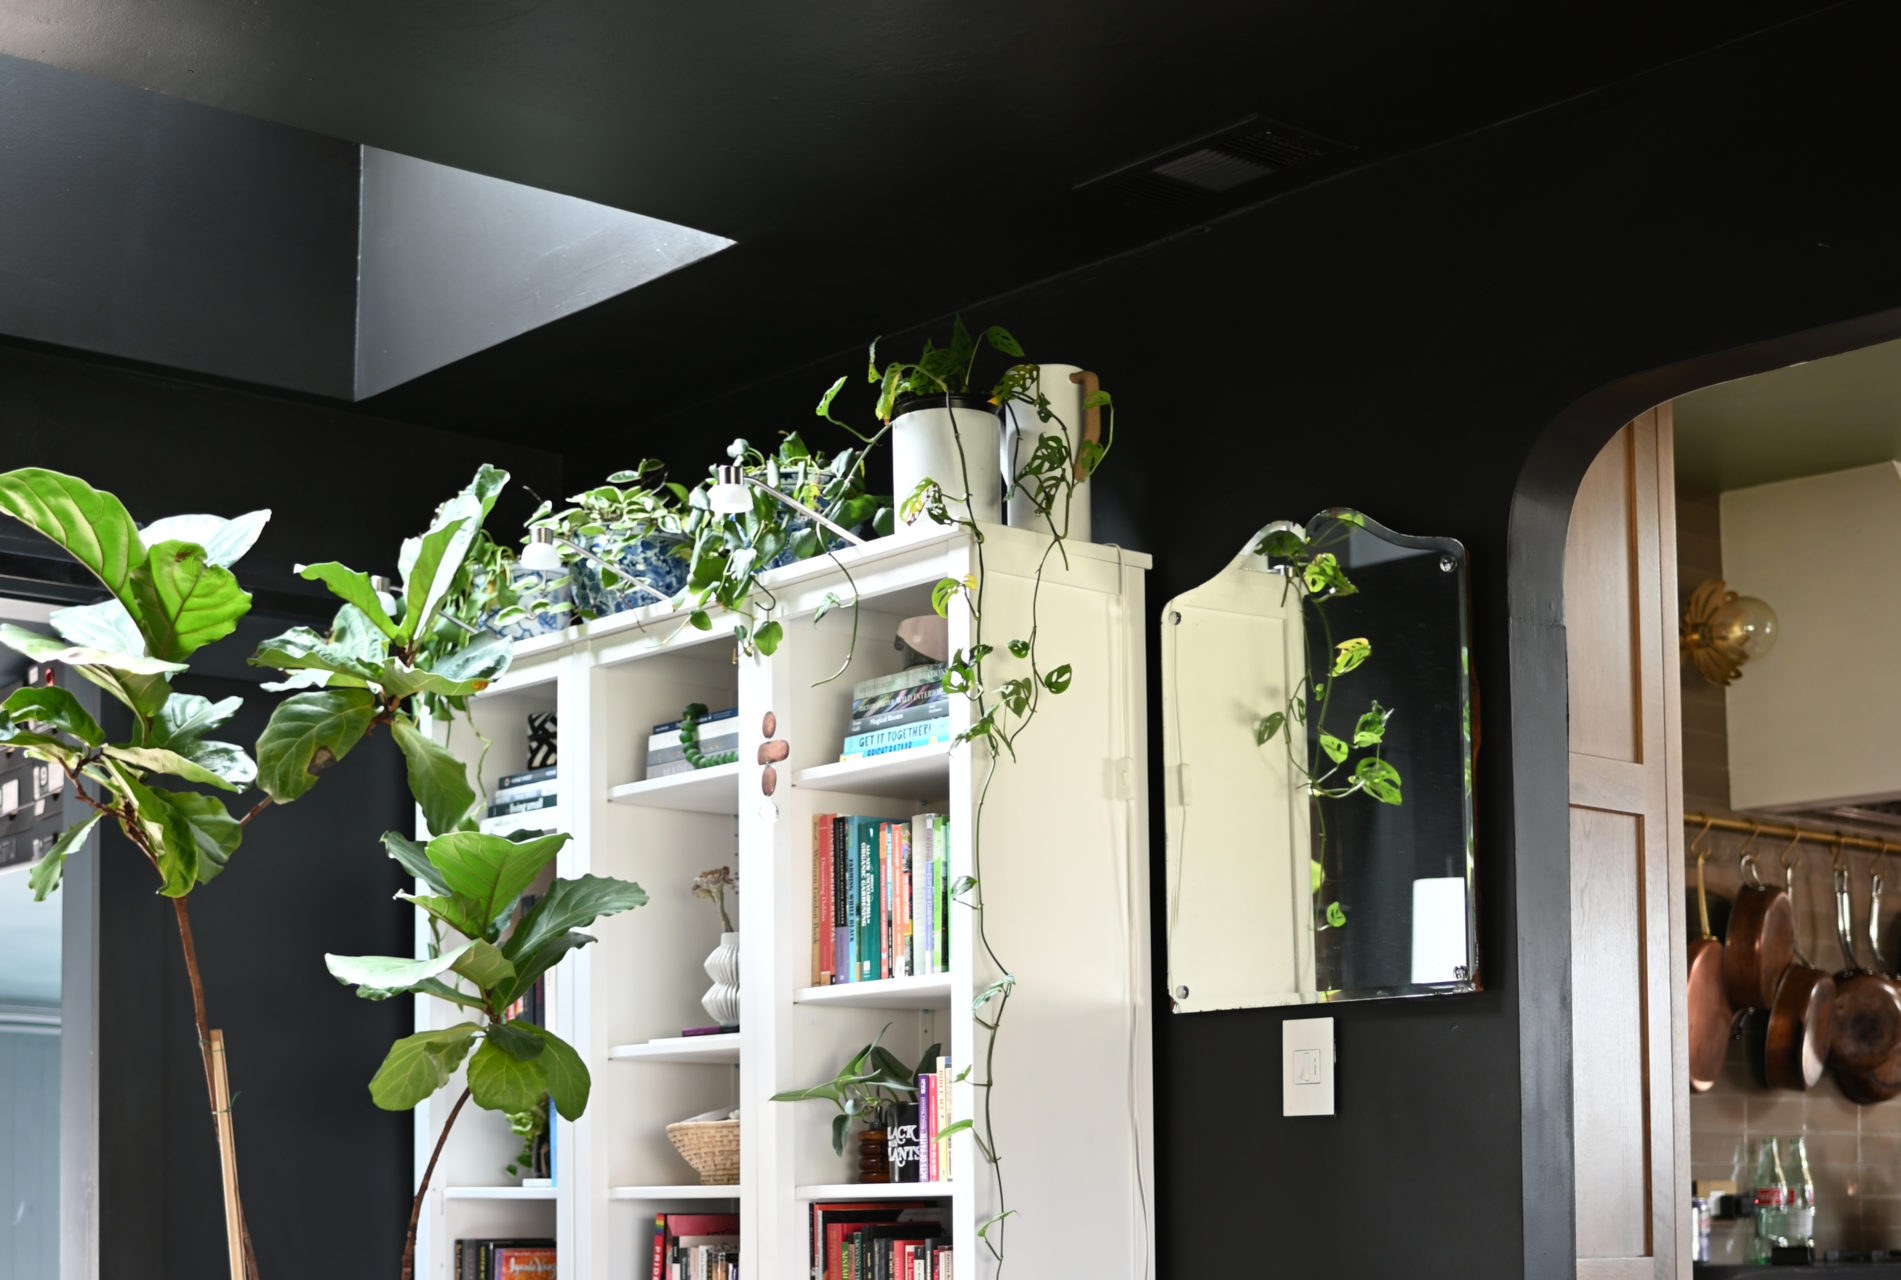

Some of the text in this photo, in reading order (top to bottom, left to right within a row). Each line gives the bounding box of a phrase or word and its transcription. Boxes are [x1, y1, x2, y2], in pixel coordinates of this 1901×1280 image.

[859, 723, 932, 748] GET IT TOGETHER!
[886, 1124, 920, 1145] LACK
[888, 1146, 920, 1168] LANTS
